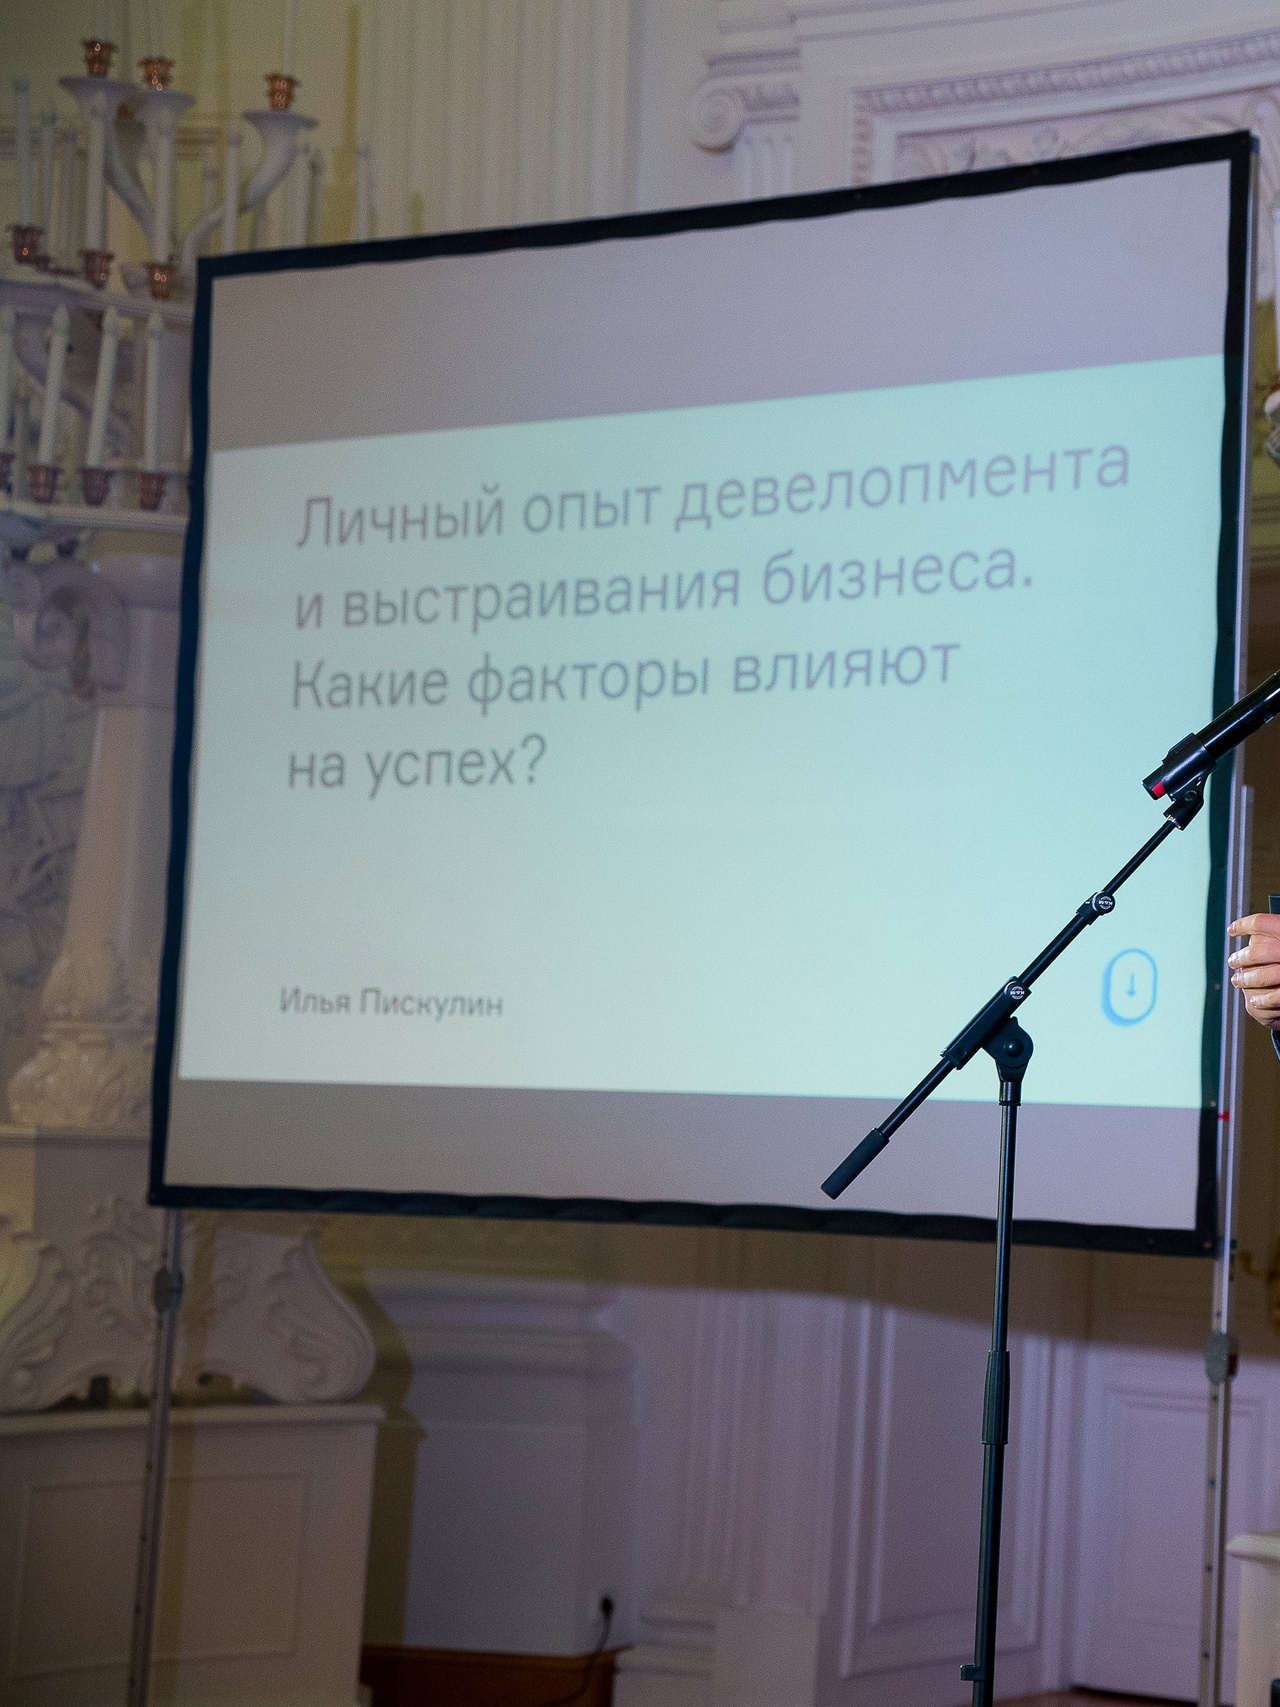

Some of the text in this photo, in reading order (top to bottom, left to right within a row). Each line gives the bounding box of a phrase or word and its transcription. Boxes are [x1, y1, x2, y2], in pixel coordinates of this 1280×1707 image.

[297, 443, 1131, 548] Личный опыт девелопмента
[296, 546, 1034, 635] и выстраивания бизнеса.
[292, 642, 961, 716] Какие факторы влияют
[289, 733, 548, 798] на успех?
[280, 986, 503, 1022] Илья Пискулин
